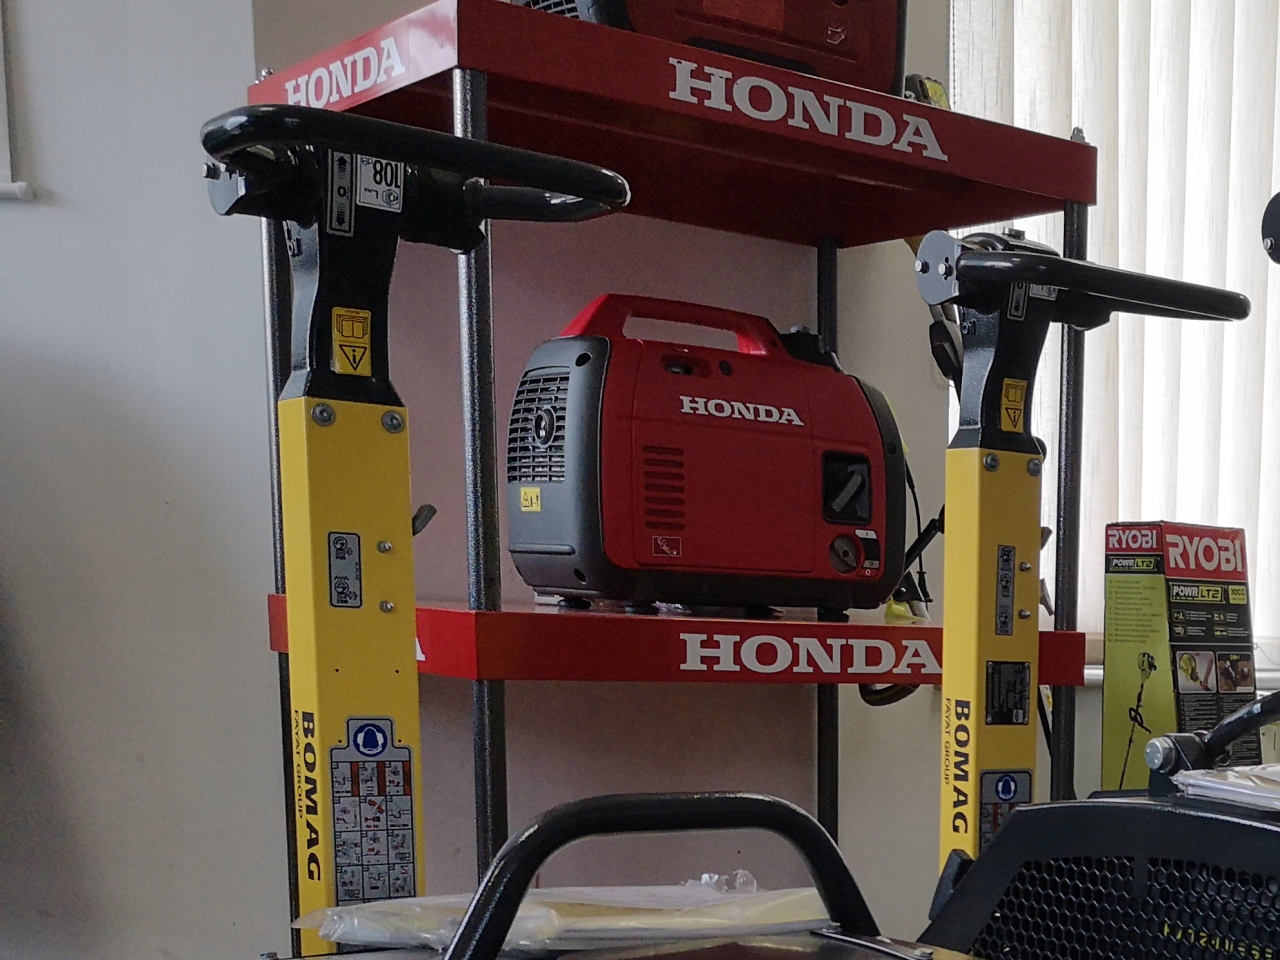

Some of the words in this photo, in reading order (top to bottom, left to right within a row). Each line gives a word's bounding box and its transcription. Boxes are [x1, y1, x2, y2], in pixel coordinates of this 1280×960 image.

[285, 37, 405, 108] HONDA
[668, 57, 948, 161] HONDA
[680, 395, 804, 426] HONDA
[1108, 529, 1157, 549] RYOBI
[1166, 534, 1243, 572] RYOBI
[1173, 586, 1198, 597] POWR
[1200, 588, 1220, 599] LT2
[679, 633, 943, 674] HONDA
[293, 709, 301, 758] FAYAT
[944, 698, 952, 737] FAYAT
[943, 740, 951, 785] GROUP
[952, 699, 971, 834] BOMAG
[302, 710, 321, 881] BOMAG
